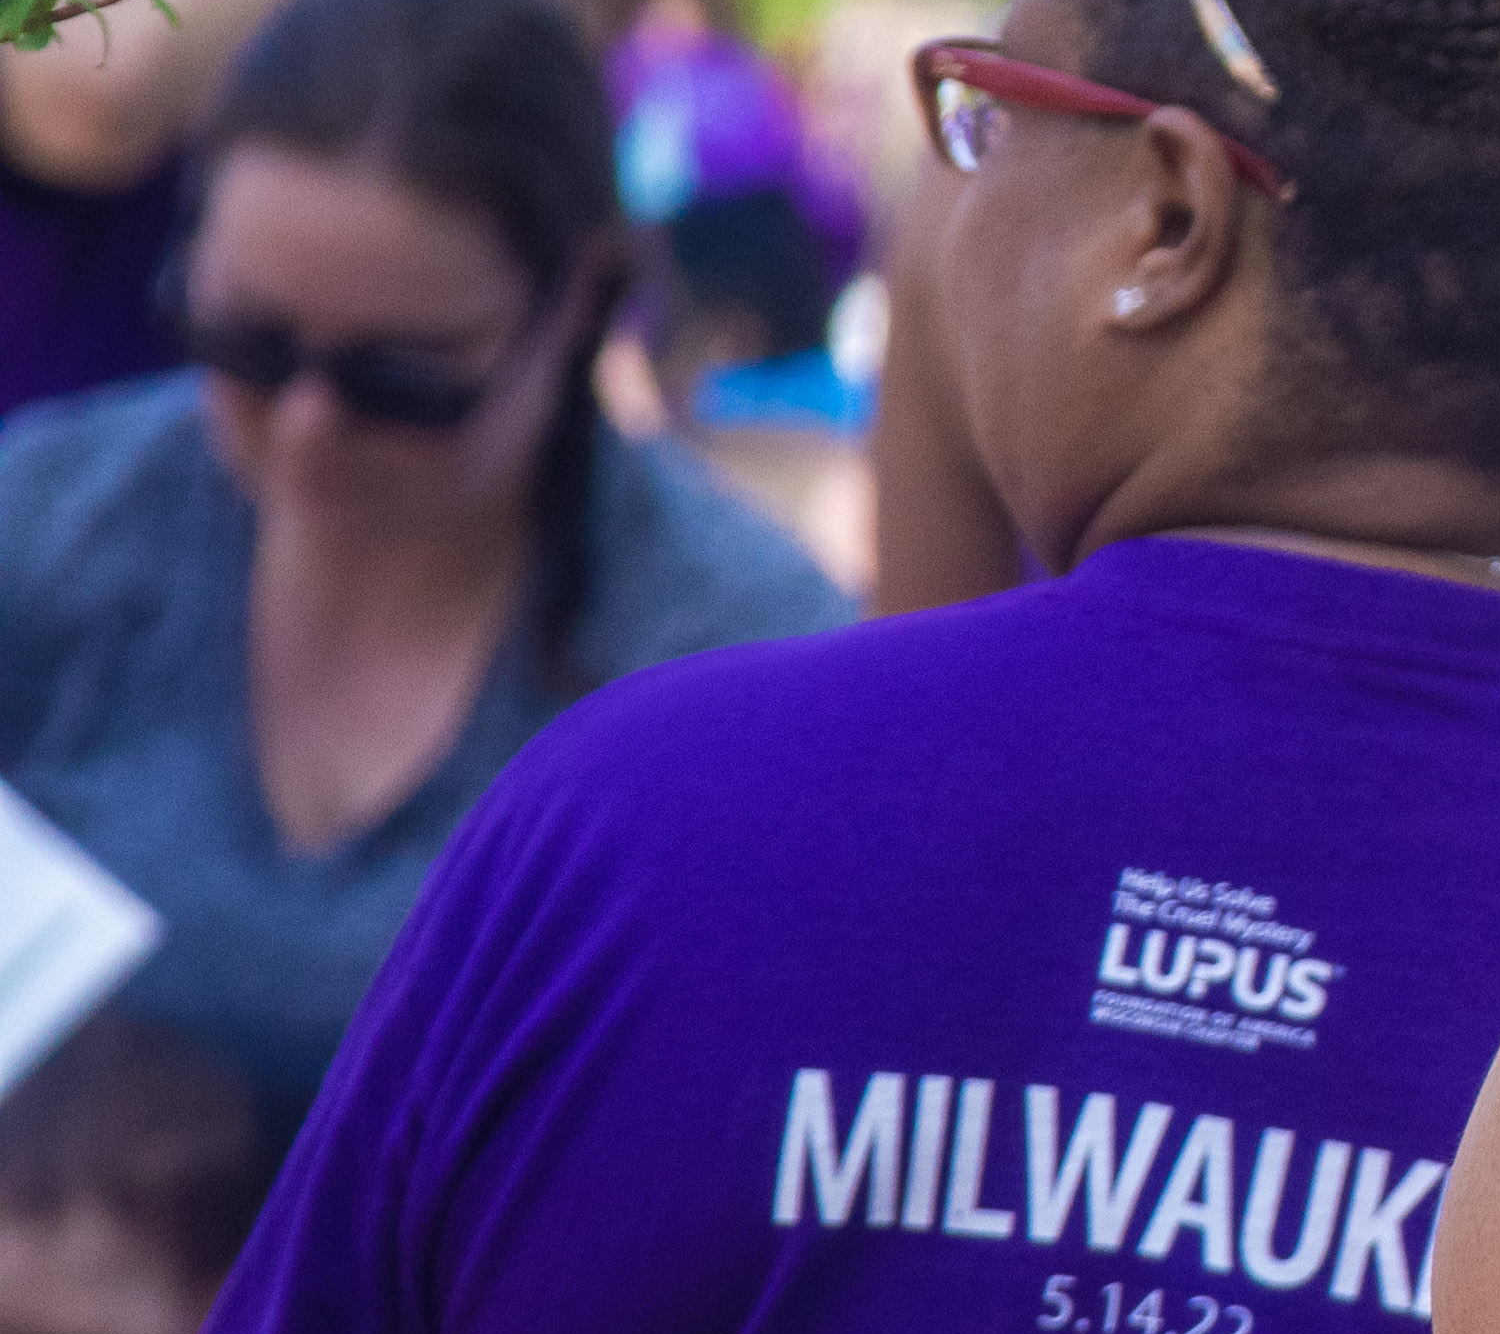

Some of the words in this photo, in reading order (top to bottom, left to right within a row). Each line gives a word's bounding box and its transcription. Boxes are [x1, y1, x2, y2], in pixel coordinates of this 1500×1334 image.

[1212, 881, 1278, 915] Solve
[1221, 909, 1317, 954] Mystery
[1098, 922, 1333, 1021] LUPUS
[771, 1068, 1452, 1322] MILWAUK
